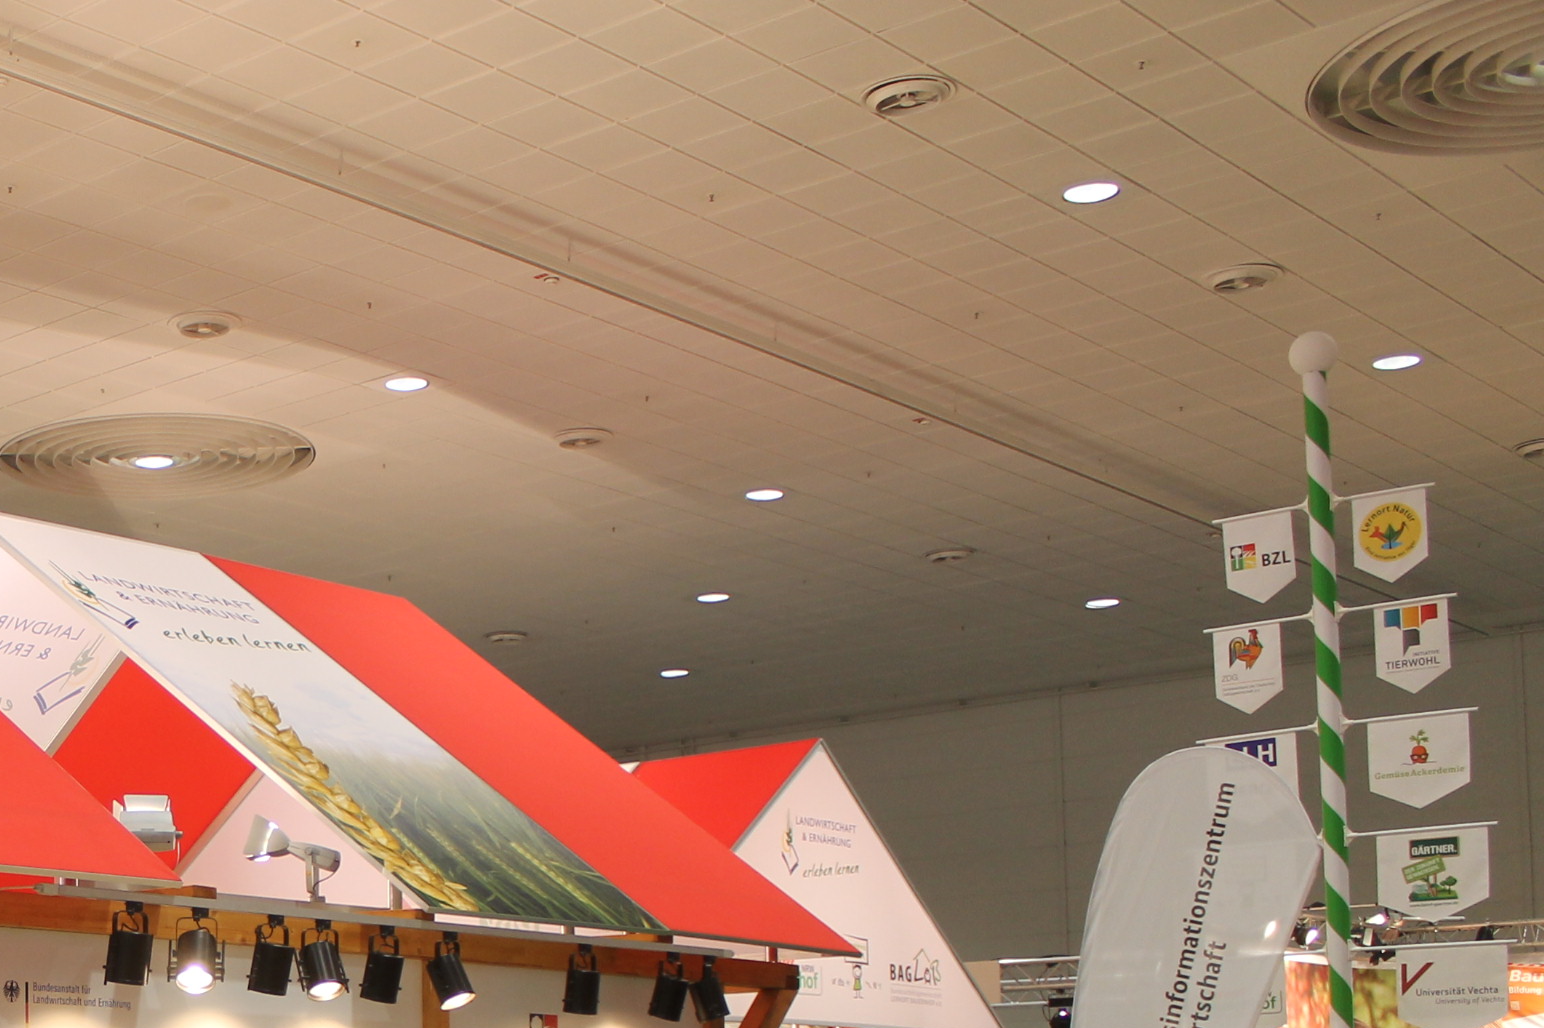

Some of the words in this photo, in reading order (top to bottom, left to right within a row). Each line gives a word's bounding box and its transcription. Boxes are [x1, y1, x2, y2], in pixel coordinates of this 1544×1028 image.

[1361, 506, 1390, 532] Lernort
[1393, 505, 1415, 521] Natur
[1262, 551, 1290, 566] BZL
[80, 570, 254, 611] LANDWIRTSCHAFT
[116, 591, 128, 601] &
[135, 593, 259, 625] ERNÄHRUNG
[163, 627, 238, 647] erleben
[241, 633, 312, 653] lernen
[1386, 656, 1440, 671] TIERWOHL
[1222, 674, 1238, 683] ZDG
[1375, 766, 1465, 780] GemüseAckerdemie
[796, 816, 856, 834] LANDWIRTSCHAFT
[809, 833, 851, 848] ERNÄHRUNG
[803, 864, 833, 878] erleben
[835, 862, 859, 876] lernen
[33, 982, 79, 995] Bundesanstalt
[81, 985, 91, 995] für
[1416, 987, 1465, 996] Universität
[1467, 986, 1498, 995] Vechta
[1508, 986, 1542, 996] Bildung
[33, 995, 82, 1006] Landwirtschaft
[83, 998, 96, 1007] und
[98, 998, 131, 1010] Ernährung
